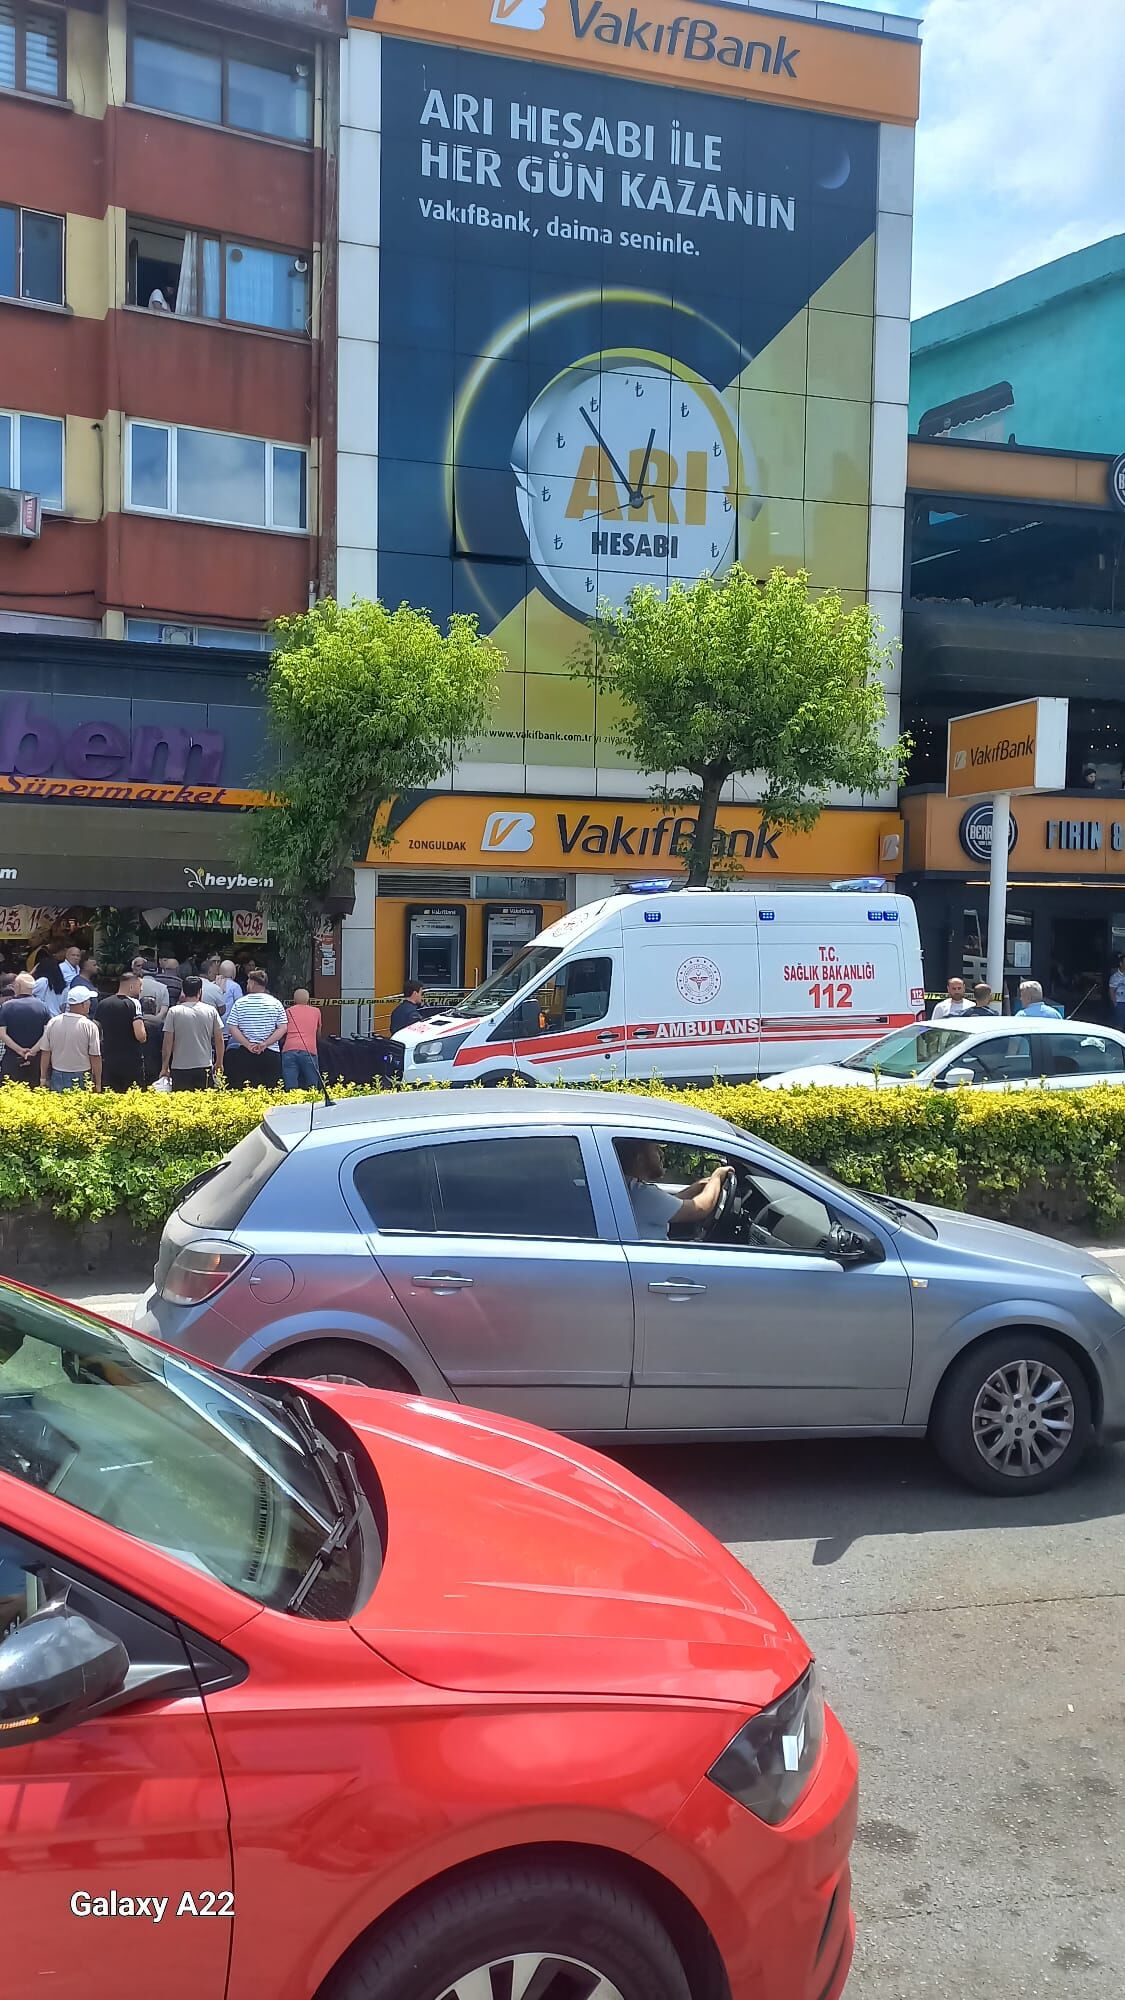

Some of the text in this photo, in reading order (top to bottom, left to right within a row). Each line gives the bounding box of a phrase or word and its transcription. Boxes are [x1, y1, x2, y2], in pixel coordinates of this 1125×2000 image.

[569, 0, 800, 78] VakıfBank
[419, 89, 722, 172] ARI HESABI İLE
[420, 139, 795, 231] HER GÜN KAZANIN
[418, 198, 700, 256] VakıfBank, daima seninle.
[564, 445, 708, 526] ARI
[591, 531, 679, 559] HESABI
[971, 735, 1034, 767] VakıfBank
[0, 774, 228, 804] Süpermarket
[408, 839, 467, 851] ZONGULDAK
[1046, 820, 1103, 850] FIRIN
[204, 872, 275, 890] heybem
[818, 946, 839, 962] T.C.
[783, 961, 875, 981] SAĞLIK BAKANLIĞI
[808, 983, 853, 1008] 112
[911, 989, 924, 999] 112
[655, 1018, 760, 1038] AMBULANS
